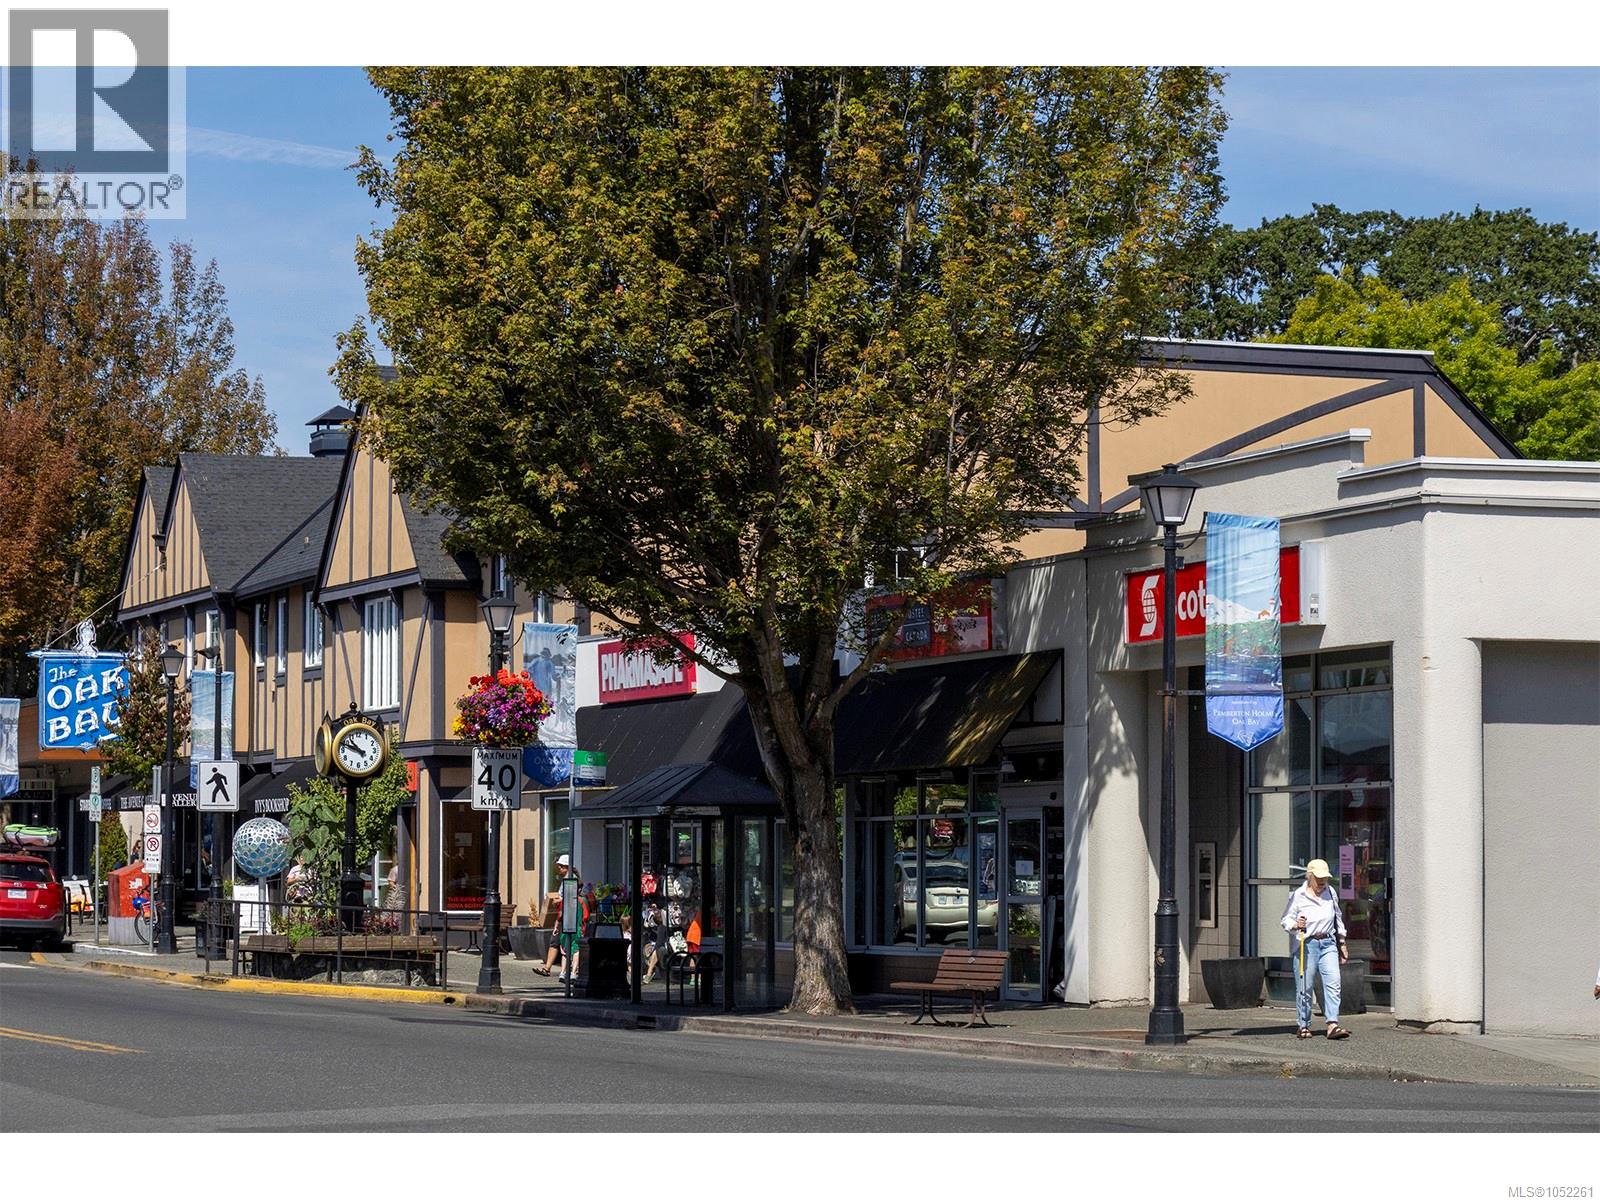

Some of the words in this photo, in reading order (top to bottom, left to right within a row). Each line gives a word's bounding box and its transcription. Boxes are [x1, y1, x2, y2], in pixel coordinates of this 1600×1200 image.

[48, 665, 78, 683] The
[47, 665, 125, 710] OAK
[343, 717, 358, 726] Oak
[361, 716, 377, 727] Bay
[477, 751, 518, 761] MAXIMUM
[478, 764, 516, 792] 40
[480, 796, 513, 806] km/h
